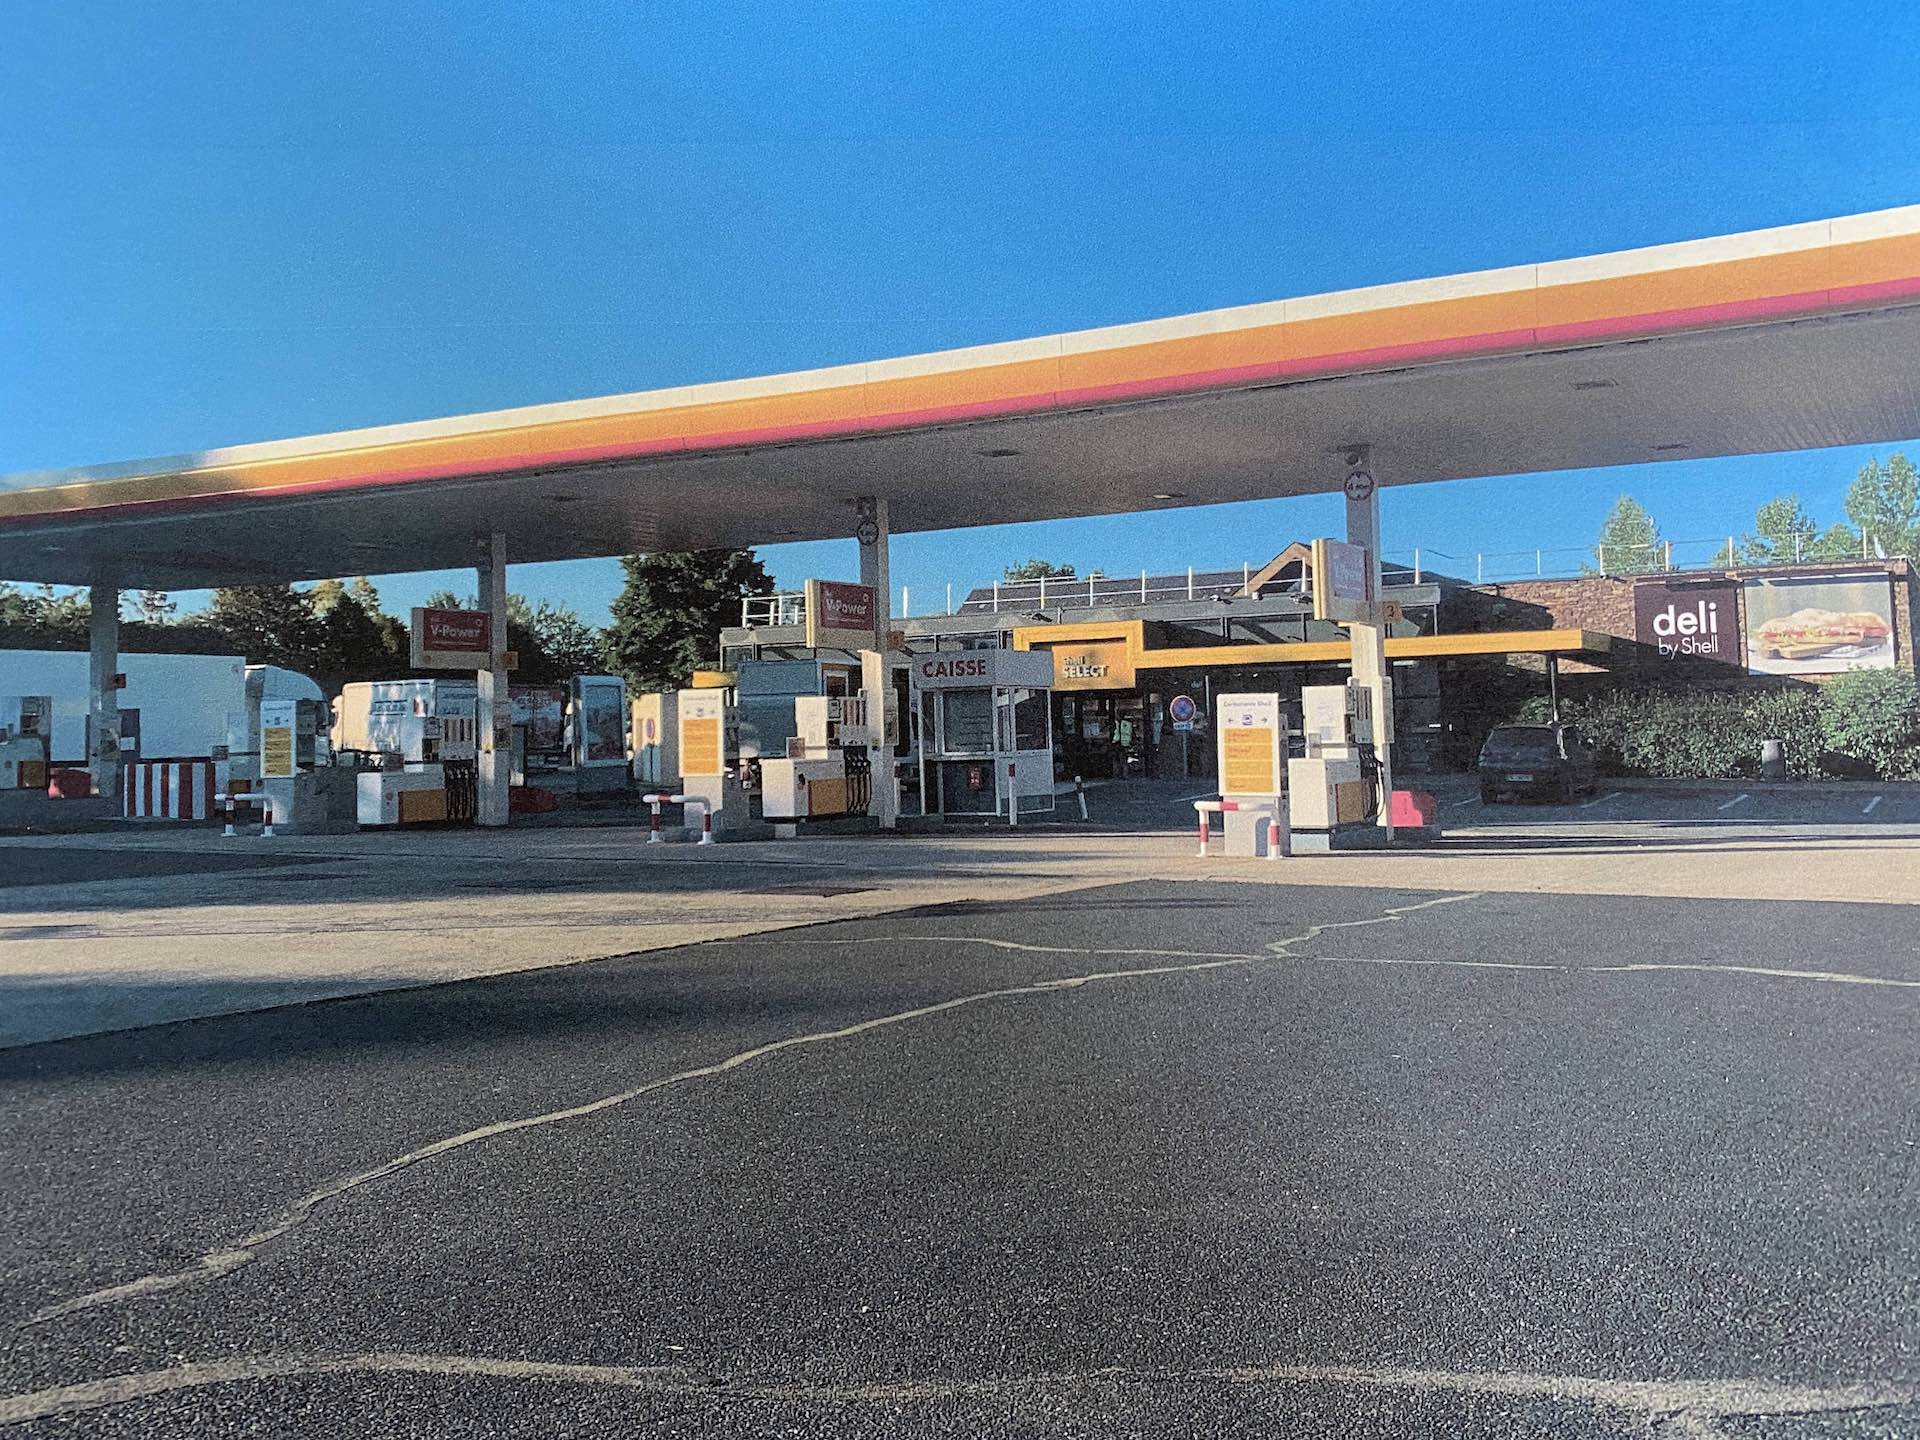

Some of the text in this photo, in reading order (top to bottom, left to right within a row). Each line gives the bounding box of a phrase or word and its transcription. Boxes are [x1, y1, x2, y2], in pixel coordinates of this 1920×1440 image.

[825, 598, 867, 616] V-Power
[1653, 600, 1717, 636] deli
[430, 624, 481, 639] V-Power
[1658, 634, 1719, 660] by Shell
[922, 659, 987, 678] CAISSE
[1063, 665, 1110, 679] SELECT
